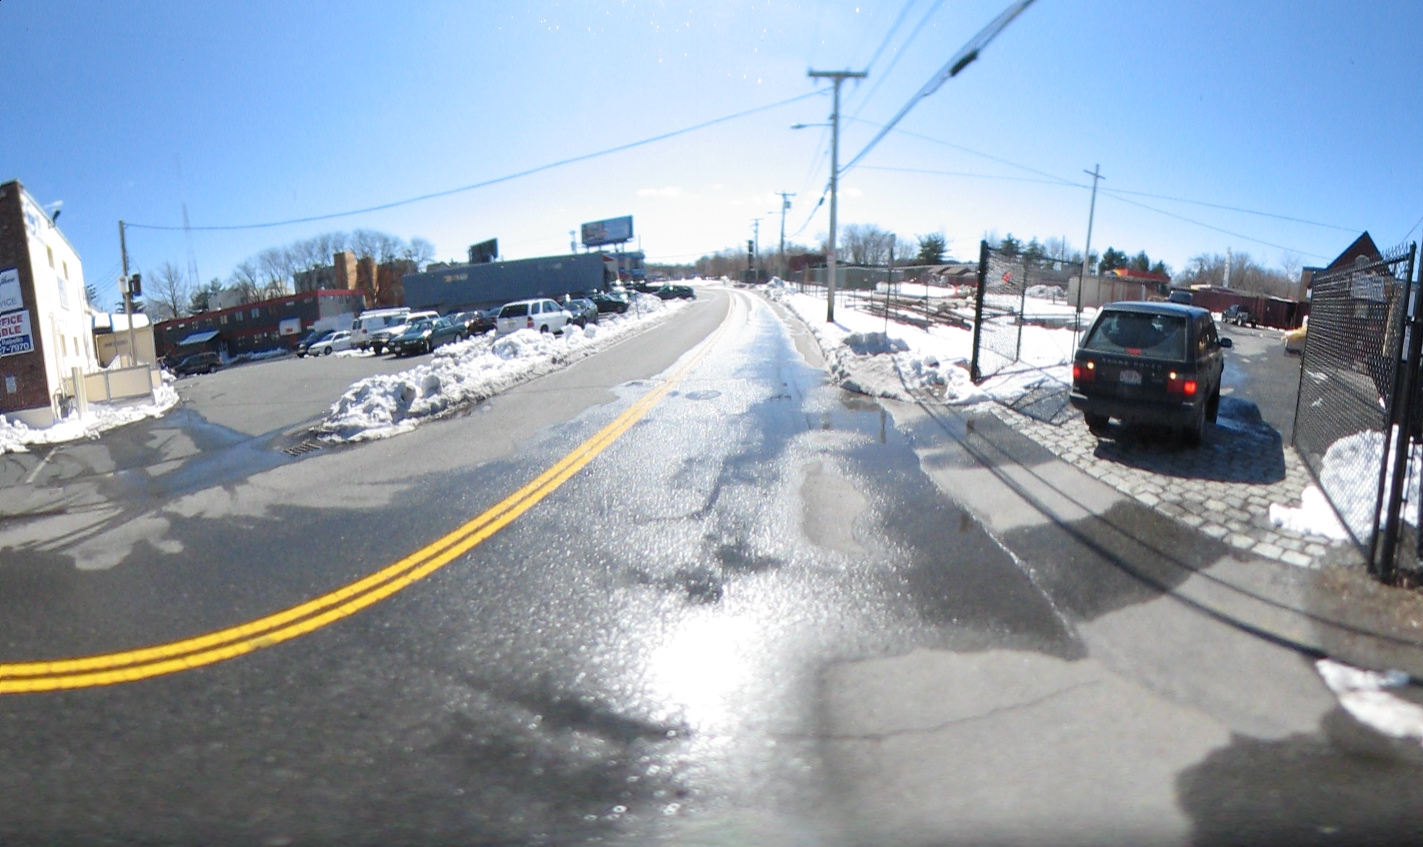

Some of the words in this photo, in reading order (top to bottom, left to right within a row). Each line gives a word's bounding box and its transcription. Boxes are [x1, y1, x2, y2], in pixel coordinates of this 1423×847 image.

[0, 315, 23, 326] FICE
[0, 326, 22, 338] BLE
[0, 342, 30, 354] 7-7970
